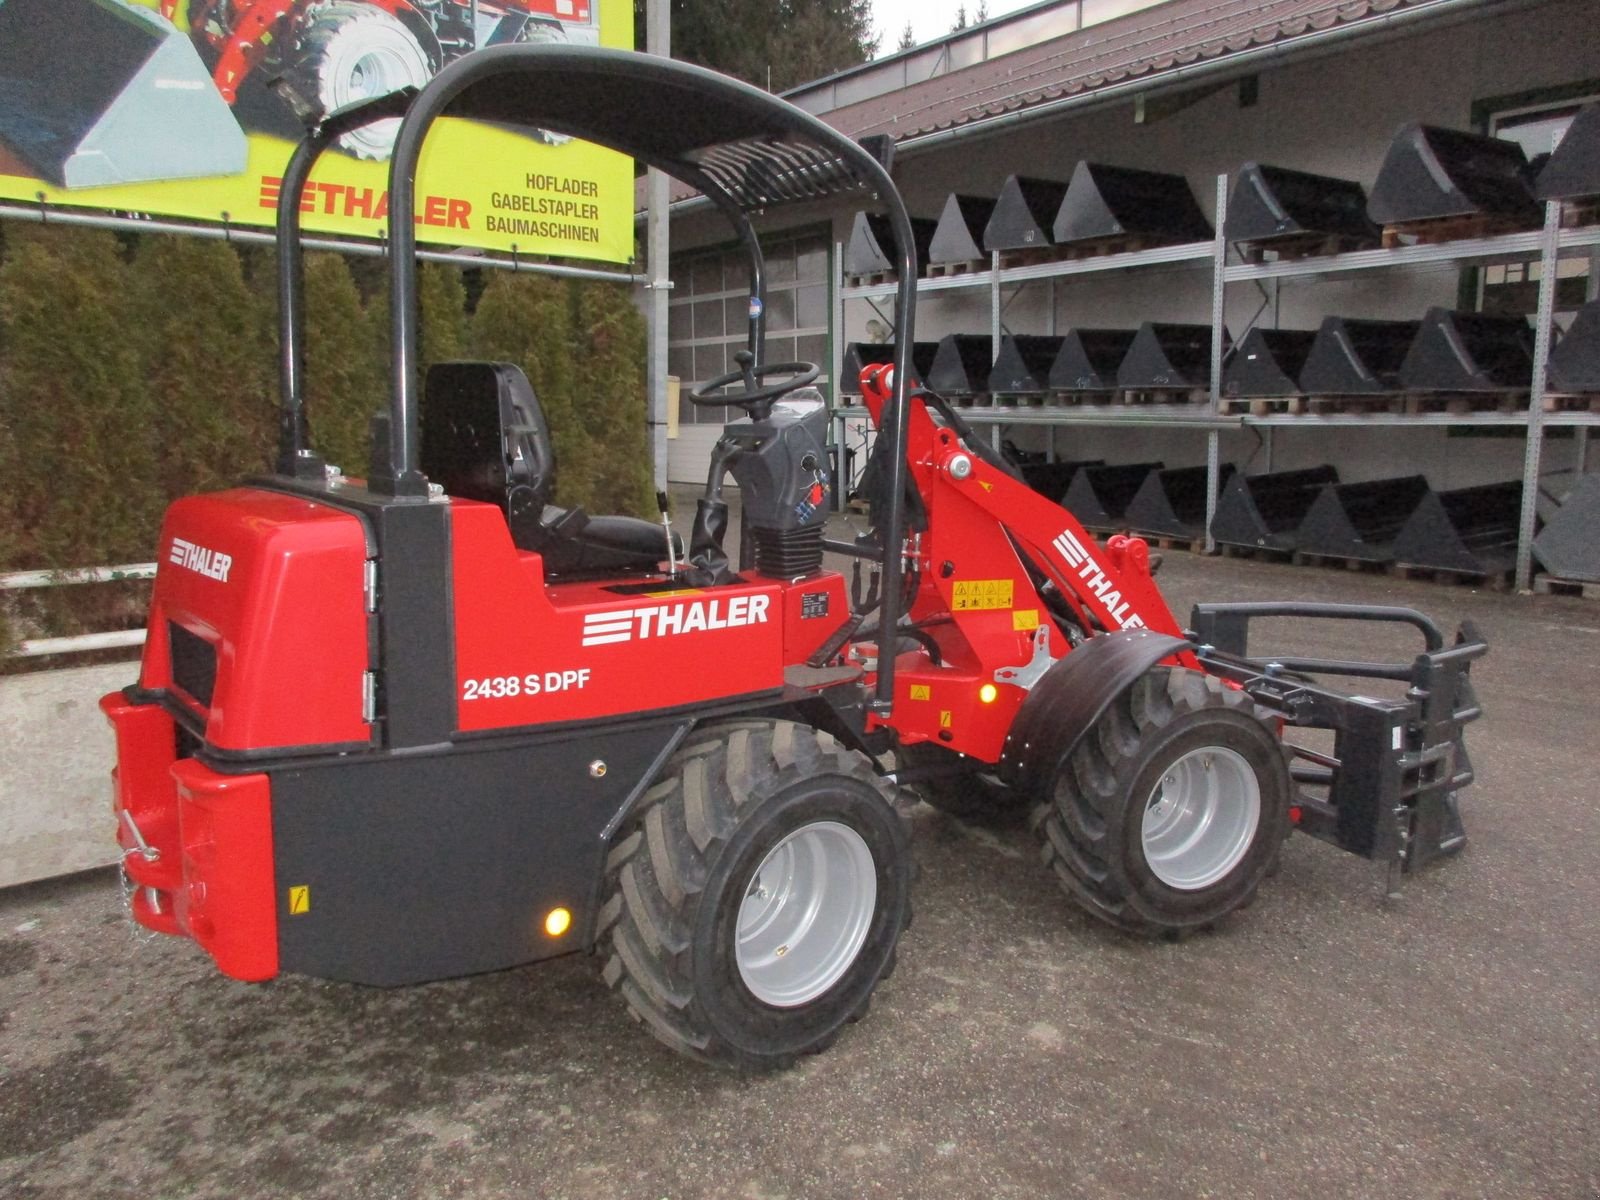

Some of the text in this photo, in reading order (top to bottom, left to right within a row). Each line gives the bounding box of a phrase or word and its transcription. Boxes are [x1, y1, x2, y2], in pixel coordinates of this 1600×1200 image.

[526, 173, 598, 198] HOFLADER
[491, 192, 599, 220] GABELSTAPLER
[486, 215, 599, 243] BAUMASCHINEN
[182, 541, 232, 583] THALER
[1078, 557, 1149, 630] THALE
[634, 594, 770, 639] THALER
[463, 668, 591, 700] 2438 S DPF
